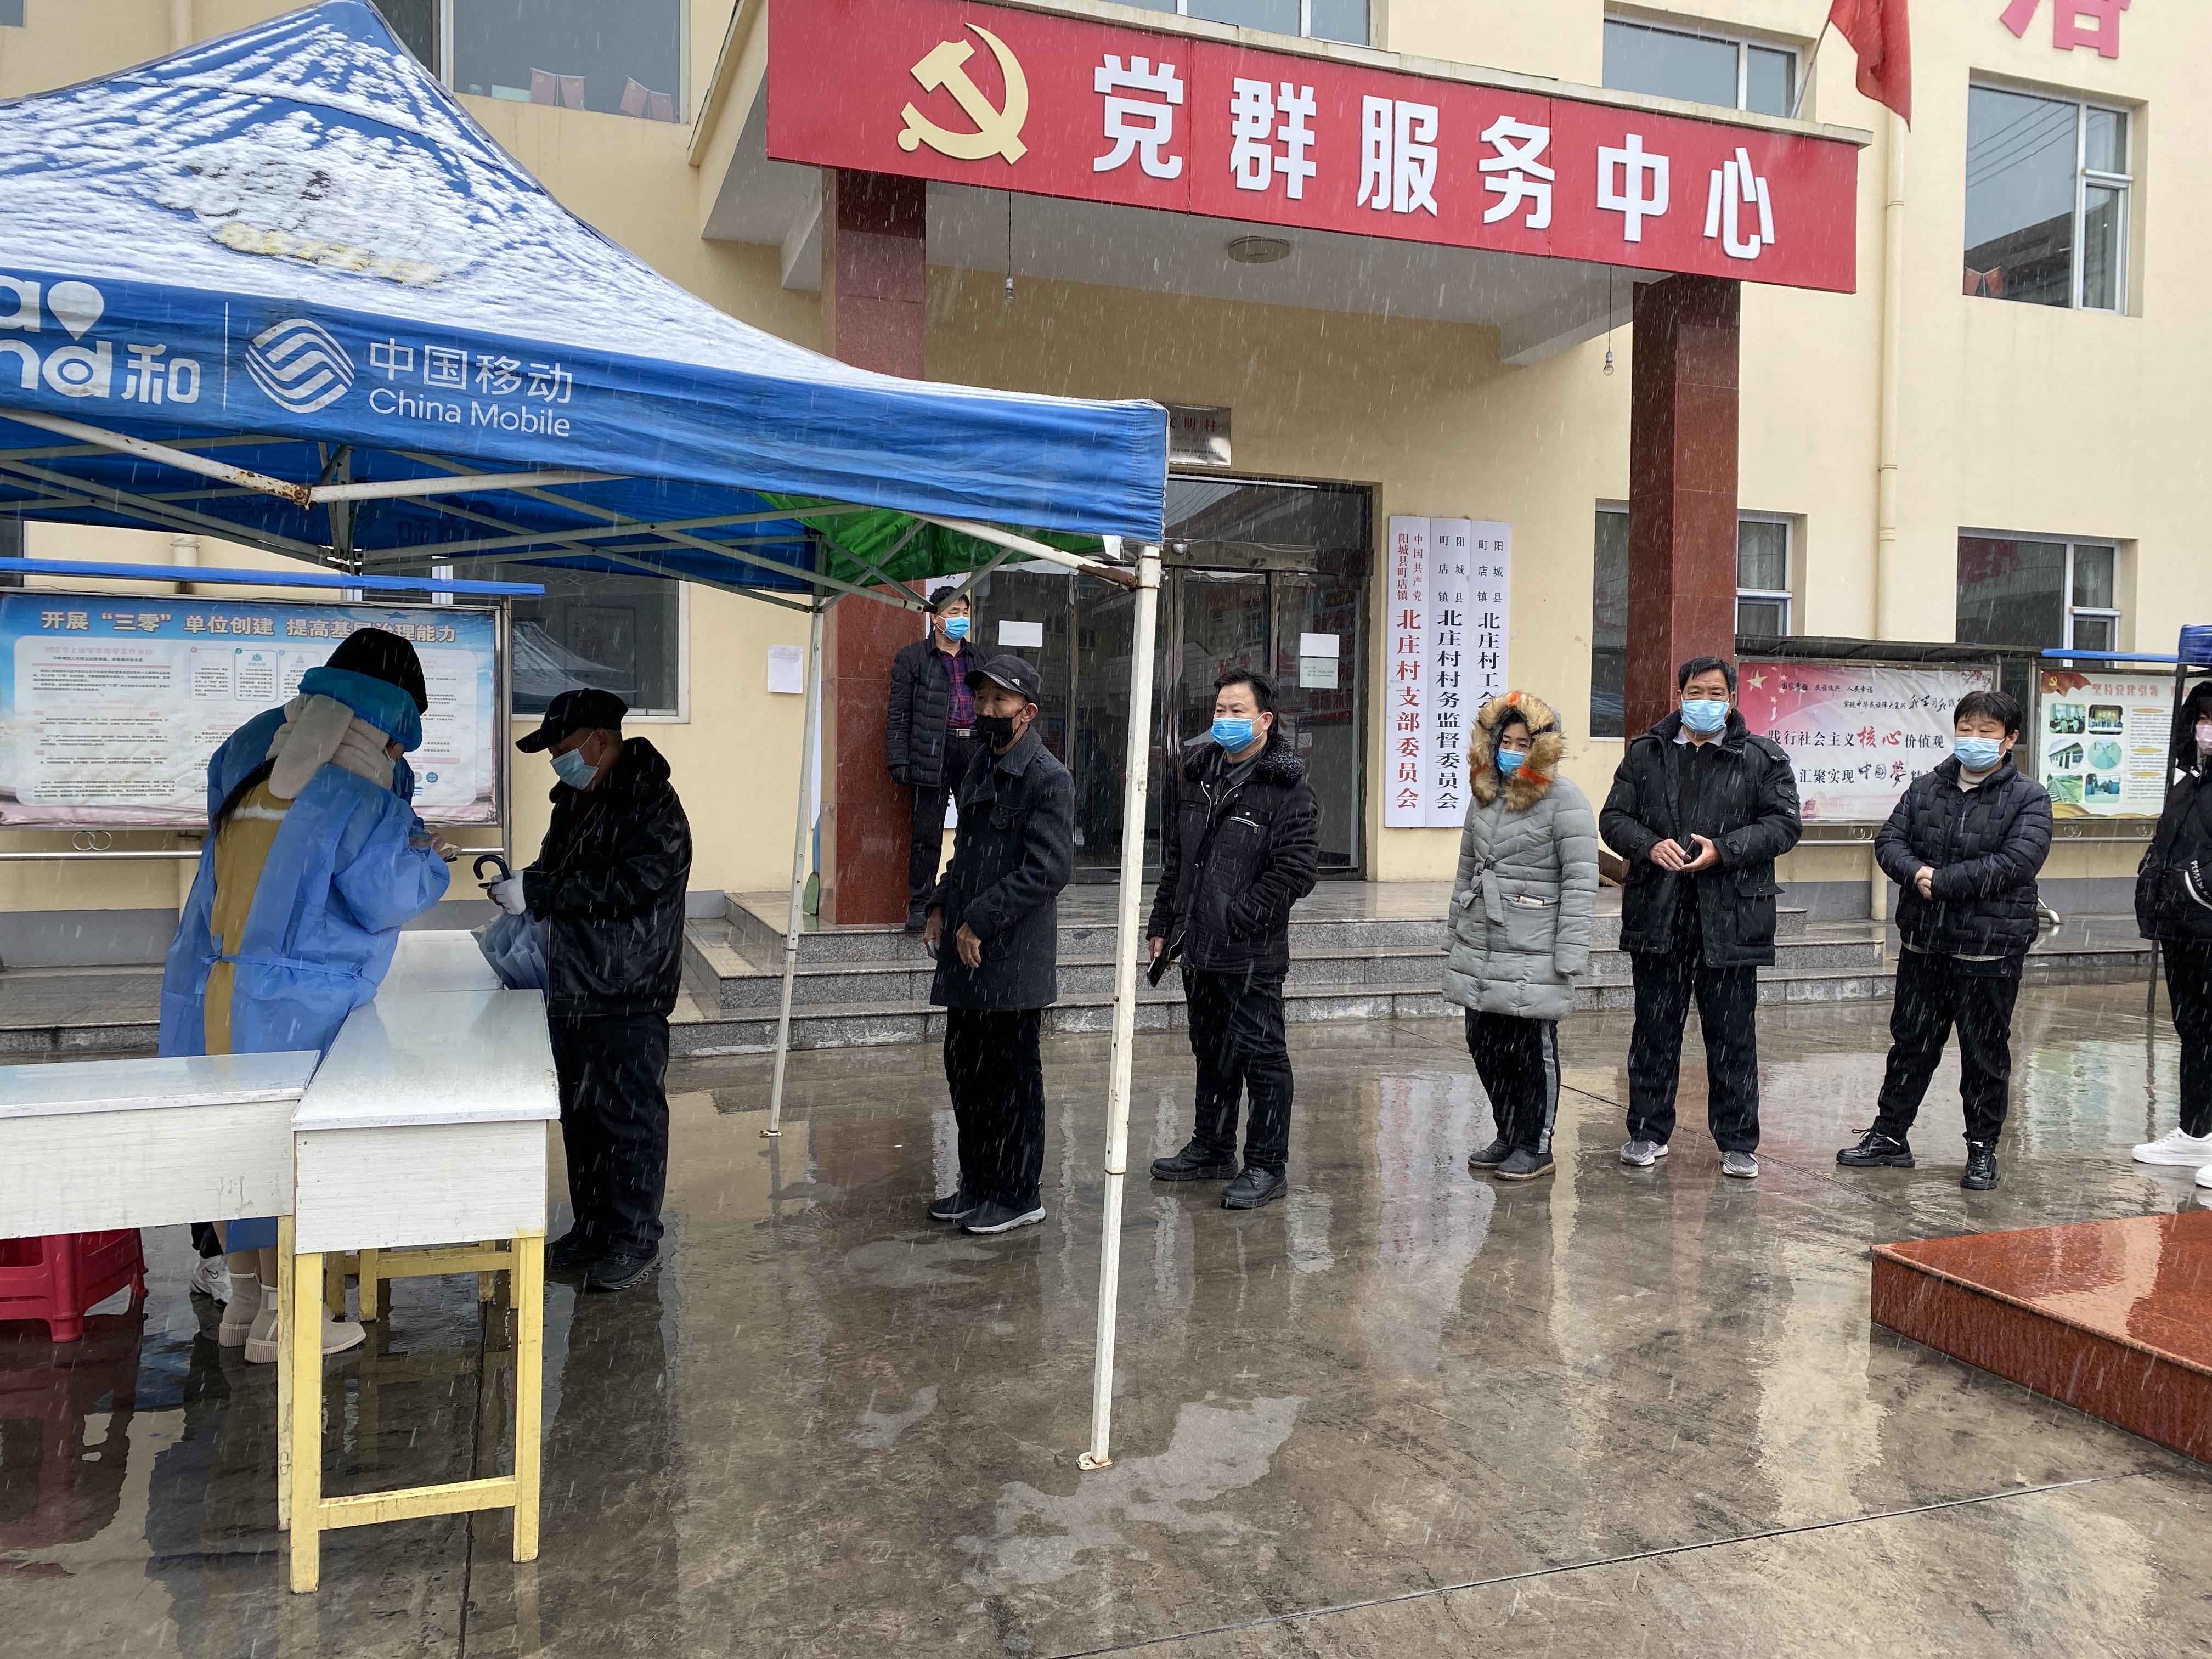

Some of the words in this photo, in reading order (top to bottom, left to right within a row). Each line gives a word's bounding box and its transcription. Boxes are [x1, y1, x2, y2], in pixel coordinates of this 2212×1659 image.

[1093, 54, 1775, 260] 党群服务中心
[121, 343, 200, 404] 和
[369, 337, 572, 404] 中国移动
[369, 387, 461, 424] China
[471, 400, 571, 437] Mobile
[1397, 533, 1409, 601] 阳城县町店镇
[1413, 533, 1424, 602] 中国共产党
[1438, 535, 1449, 603] 町店镇
[1454, 535, 1465, 603] 阳城县
[1477, 539, 1488, 603] 町店镇
[1493, 540, 1504, 604] 阳城县
[41, 611, 89, 631] 开展
[183, 614, 275, 636] 单位创建
[1396, 608, 1422, 809] 北庄村支部委员会
[1435, 609, 1463, 809] 北庄村村务监督委员会
[1768, 726, 1944, 749] 践行社会主义核心价值观
